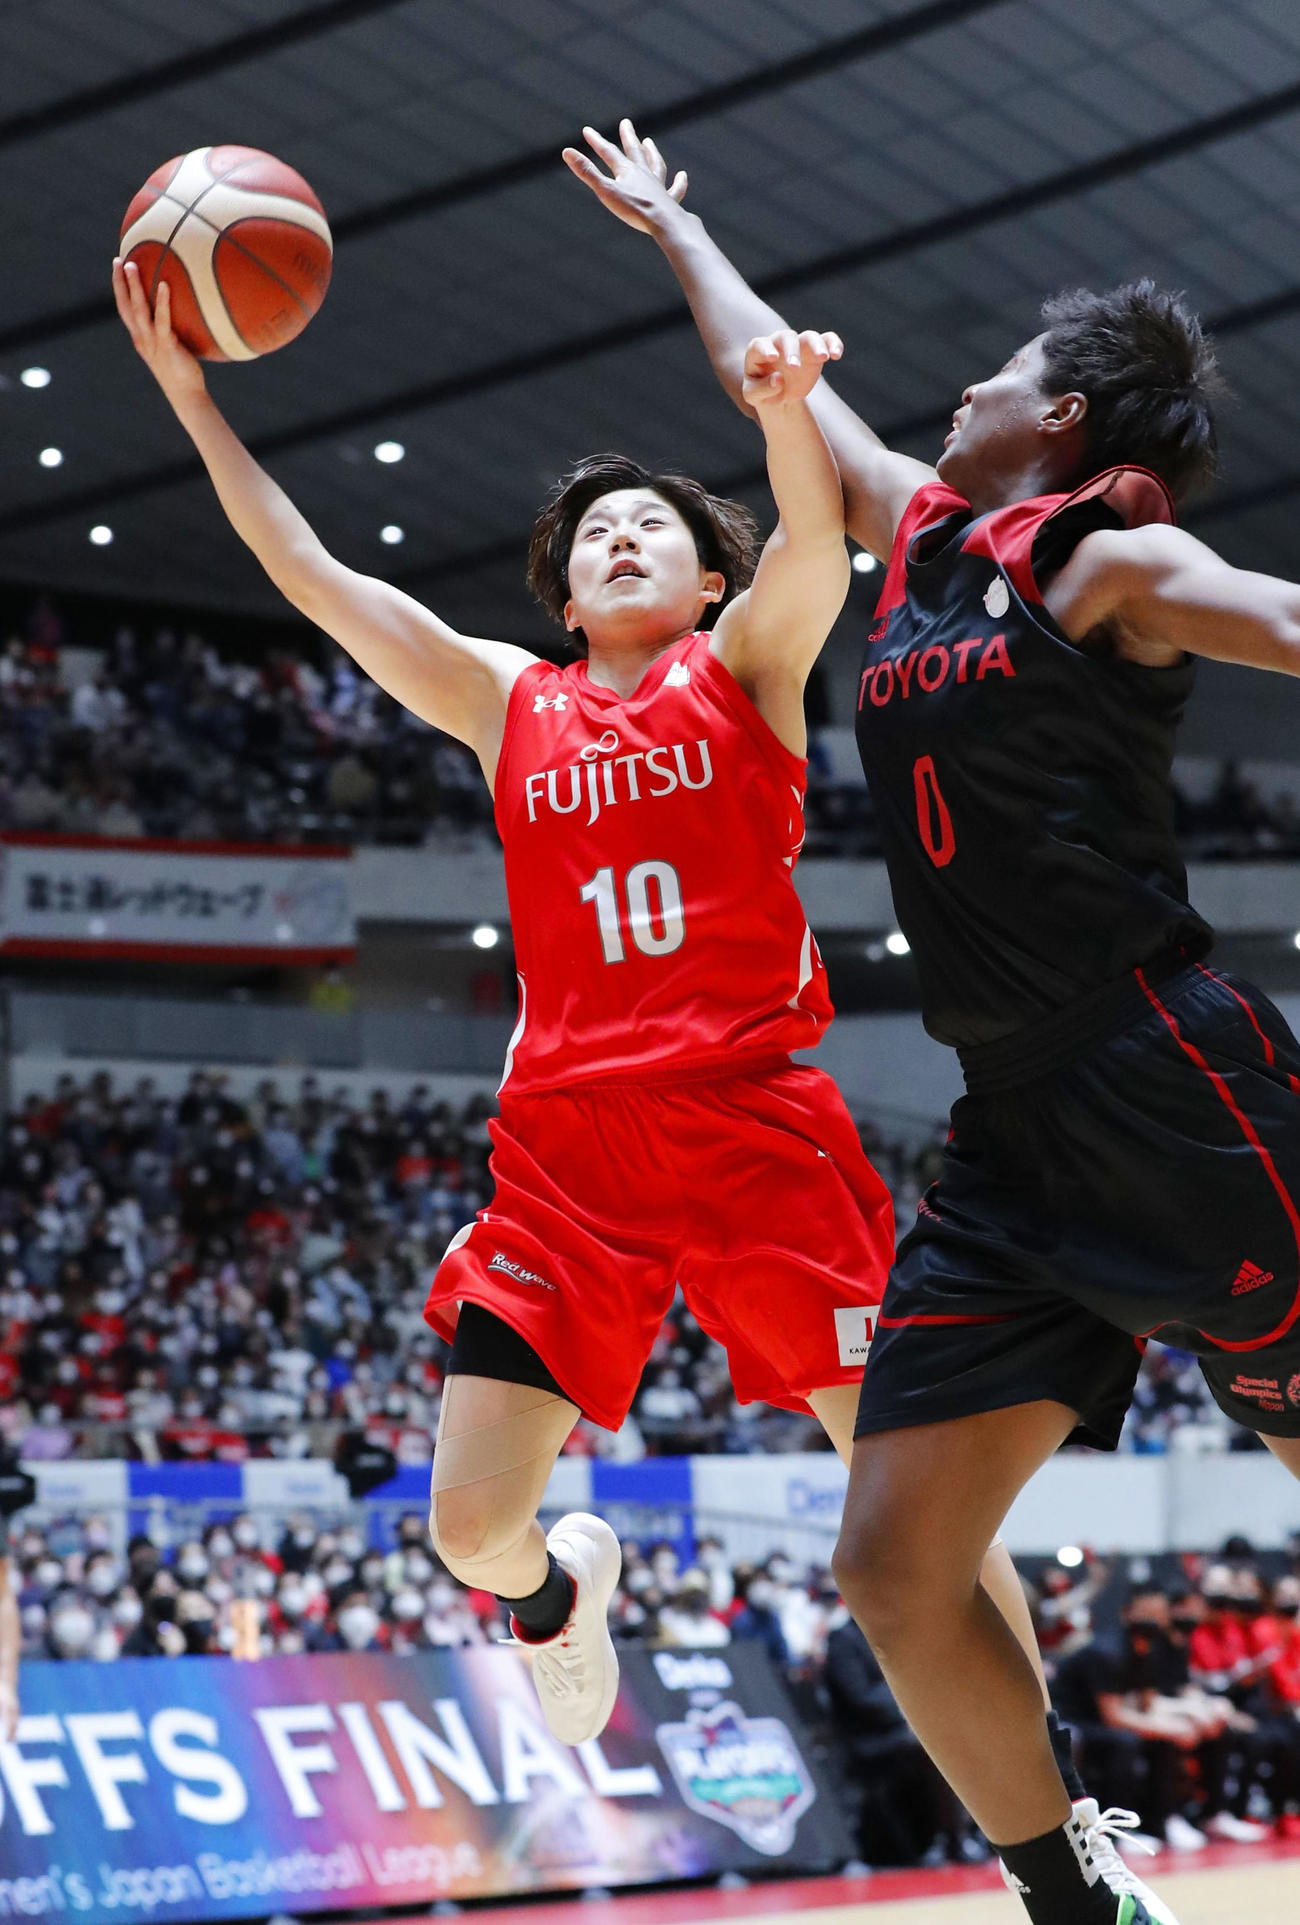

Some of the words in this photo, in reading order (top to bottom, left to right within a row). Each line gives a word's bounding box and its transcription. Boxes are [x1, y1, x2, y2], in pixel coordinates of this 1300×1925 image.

[858, 634, 1016, 711] TOYOTA
[525, 731, 713, 826] FUJITSU
[913, 754, 956, 868] 0
[580, 859, 686, 966] 10
[491, 1251, 520, 1272] Red
[519, 1269, 557, 1291] Wave
[1231, 1272, 1274, 1296] adidas
[1230, 1384, 1282, 1400] Olympics
[1236, 1374, 1278, 1389] Special
[0, 1707, 249, 1836] FFS
[253, 1699, 663, 1819] FINAL
